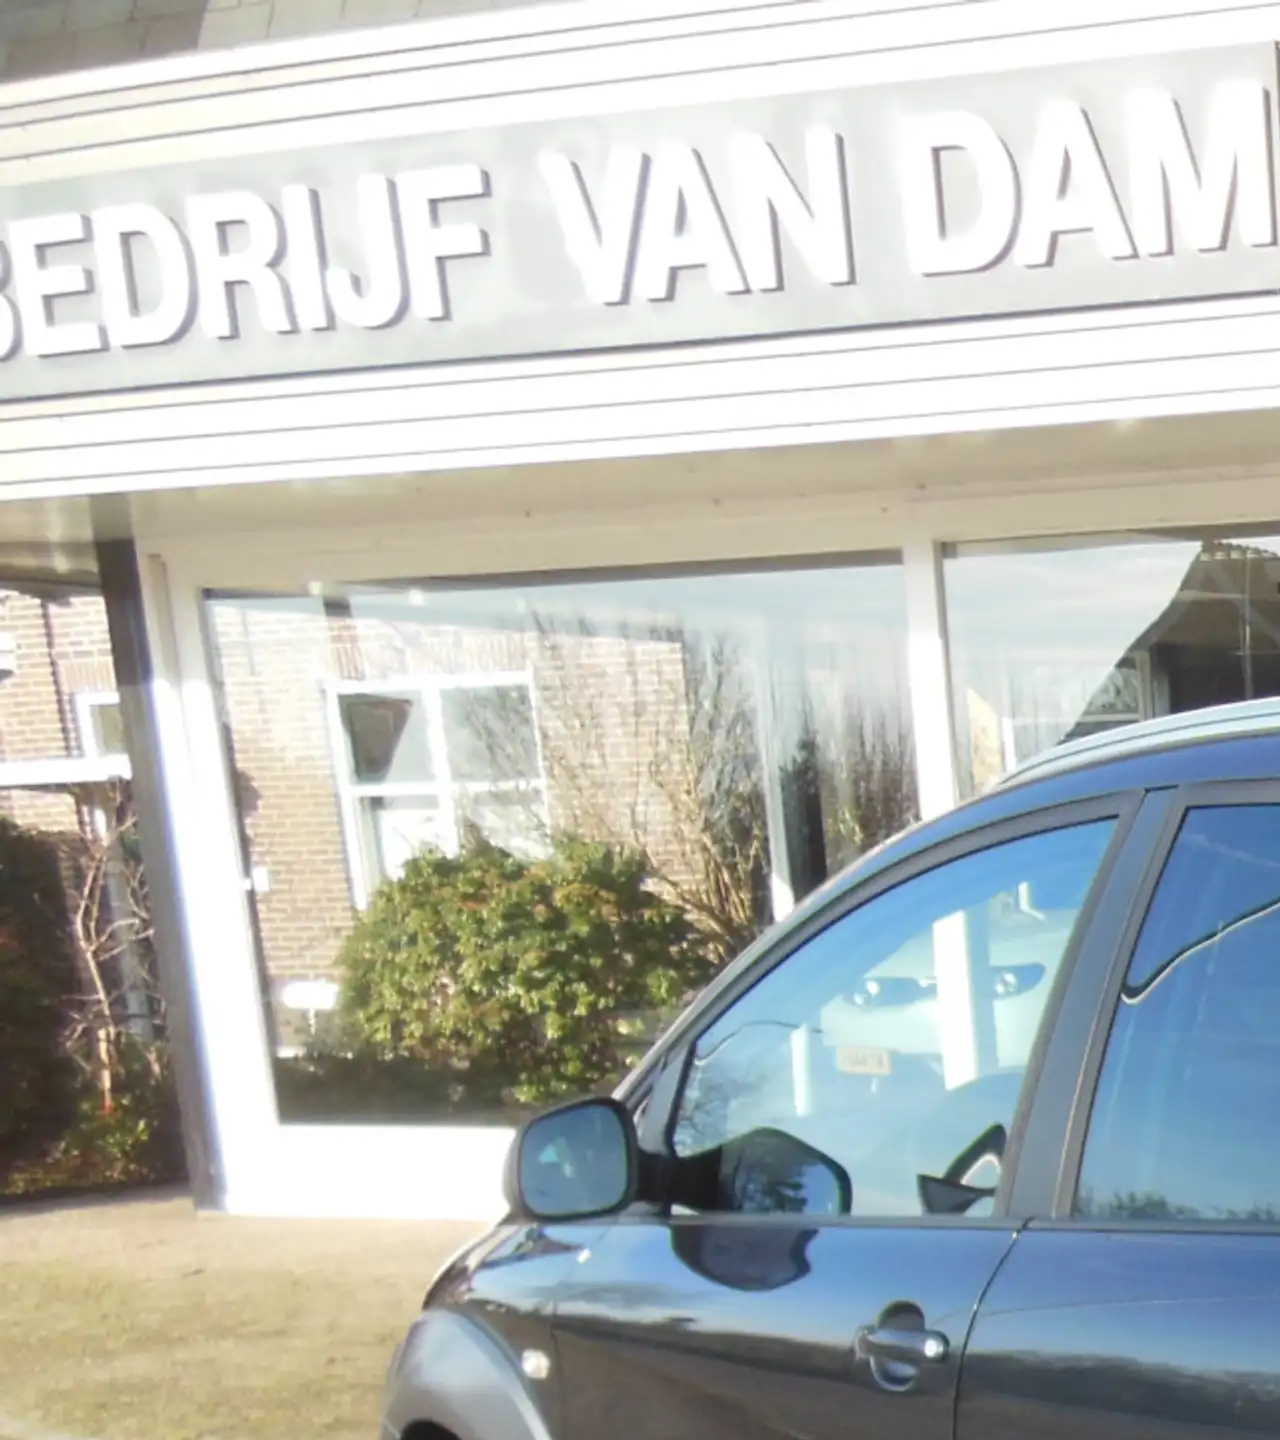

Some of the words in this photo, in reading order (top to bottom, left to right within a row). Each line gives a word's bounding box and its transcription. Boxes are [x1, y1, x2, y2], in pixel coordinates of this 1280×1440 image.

[0, 162, 491, 361] EDRIJF
[537, 121, 856, 306] VAN
[892, 79, 1279, 279] DAM
